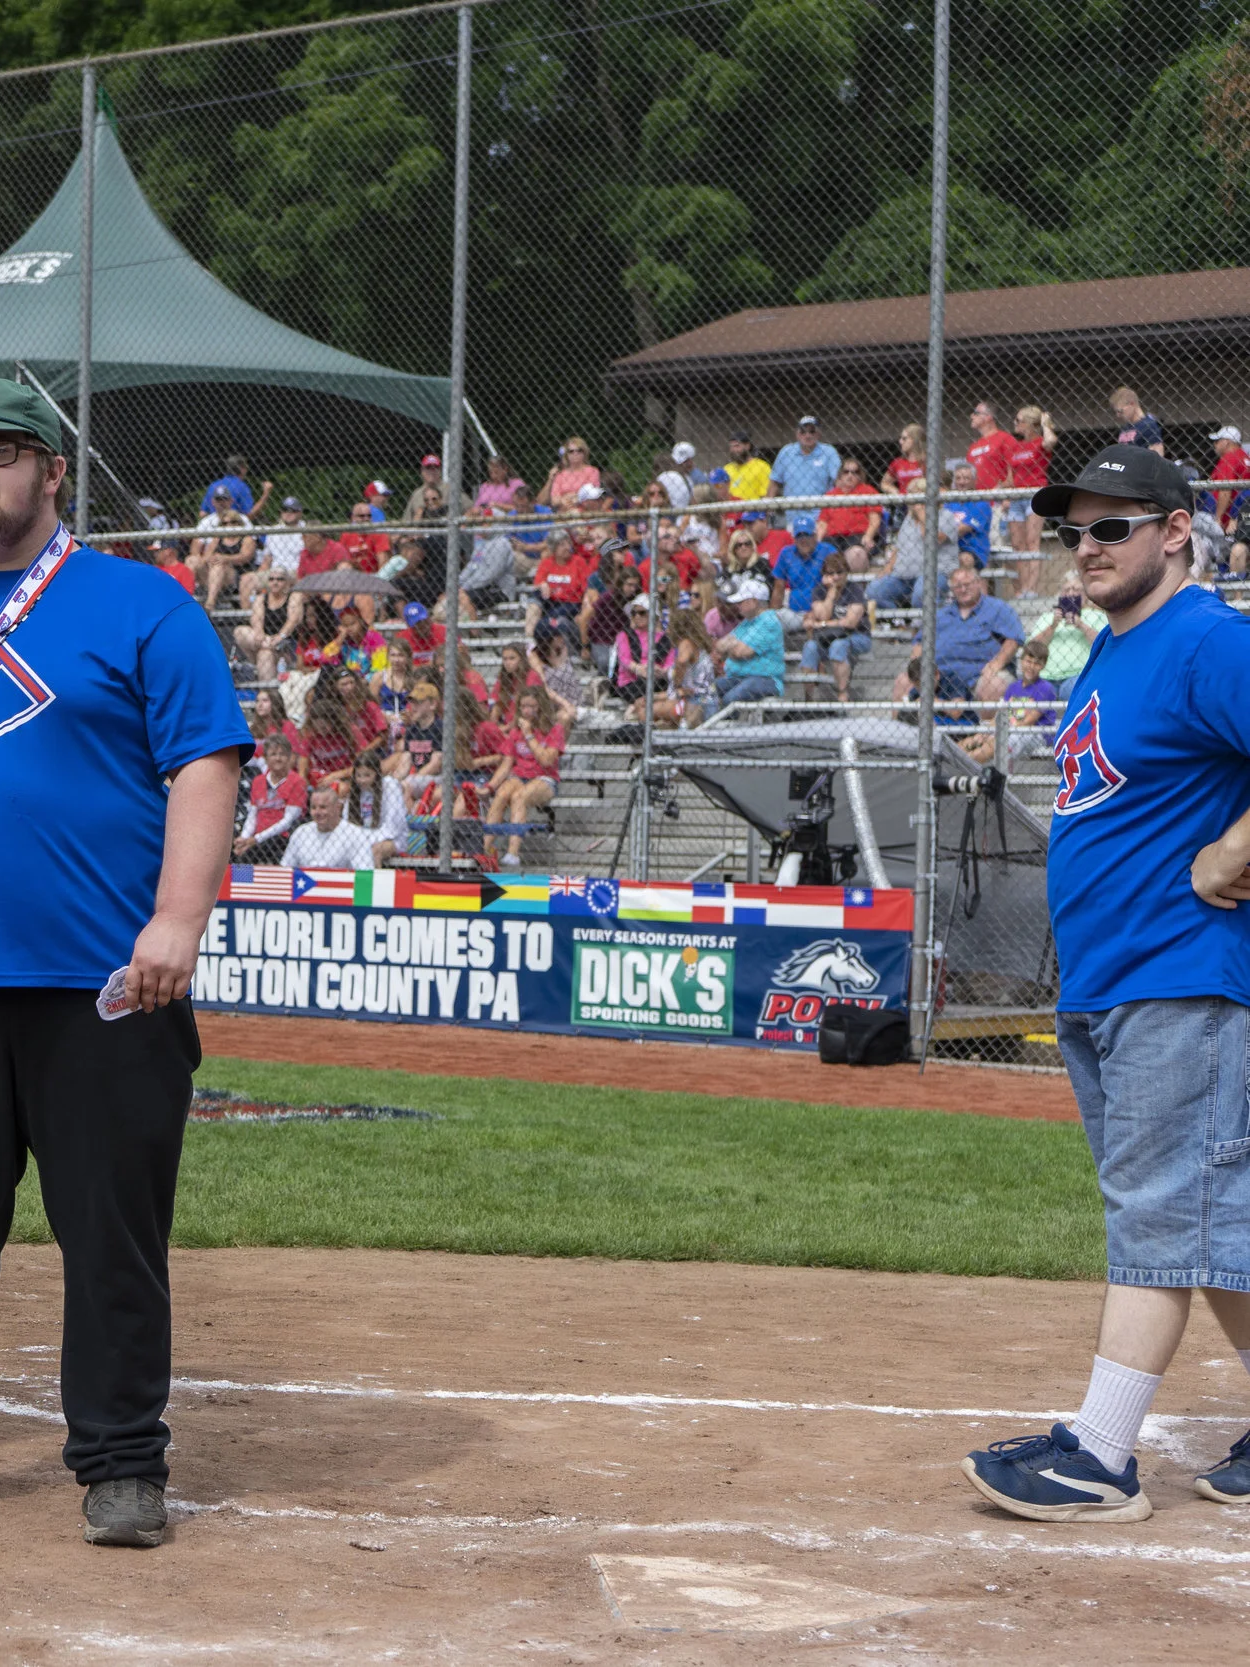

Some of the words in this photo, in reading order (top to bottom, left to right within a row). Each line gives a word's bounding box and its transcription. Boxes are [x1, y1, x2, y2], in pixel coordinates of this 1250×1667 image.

[1099, 461, 1126, 472] ASI
[234, 908, 356, 961] WORLD
[362, 914, 496, 969] COMES
[502, 920, 553, 972] TO
[573, 928, 613, 942] EVERY
[613, 930, 667, 946] SEASON
[668, 933, 717, 948] STARTS
[718, 936, 737, 949] AT
[579, 946, 727, 1013] DICK'S
[316, 962, 461, 1018] COUNTY
[467, 970, 520, 1022] PA
[581, 1005, 660, 1025] SPORTING
[755, 1026, 794, 1042] Protect
[795, 1027, 814, 1044] Our
